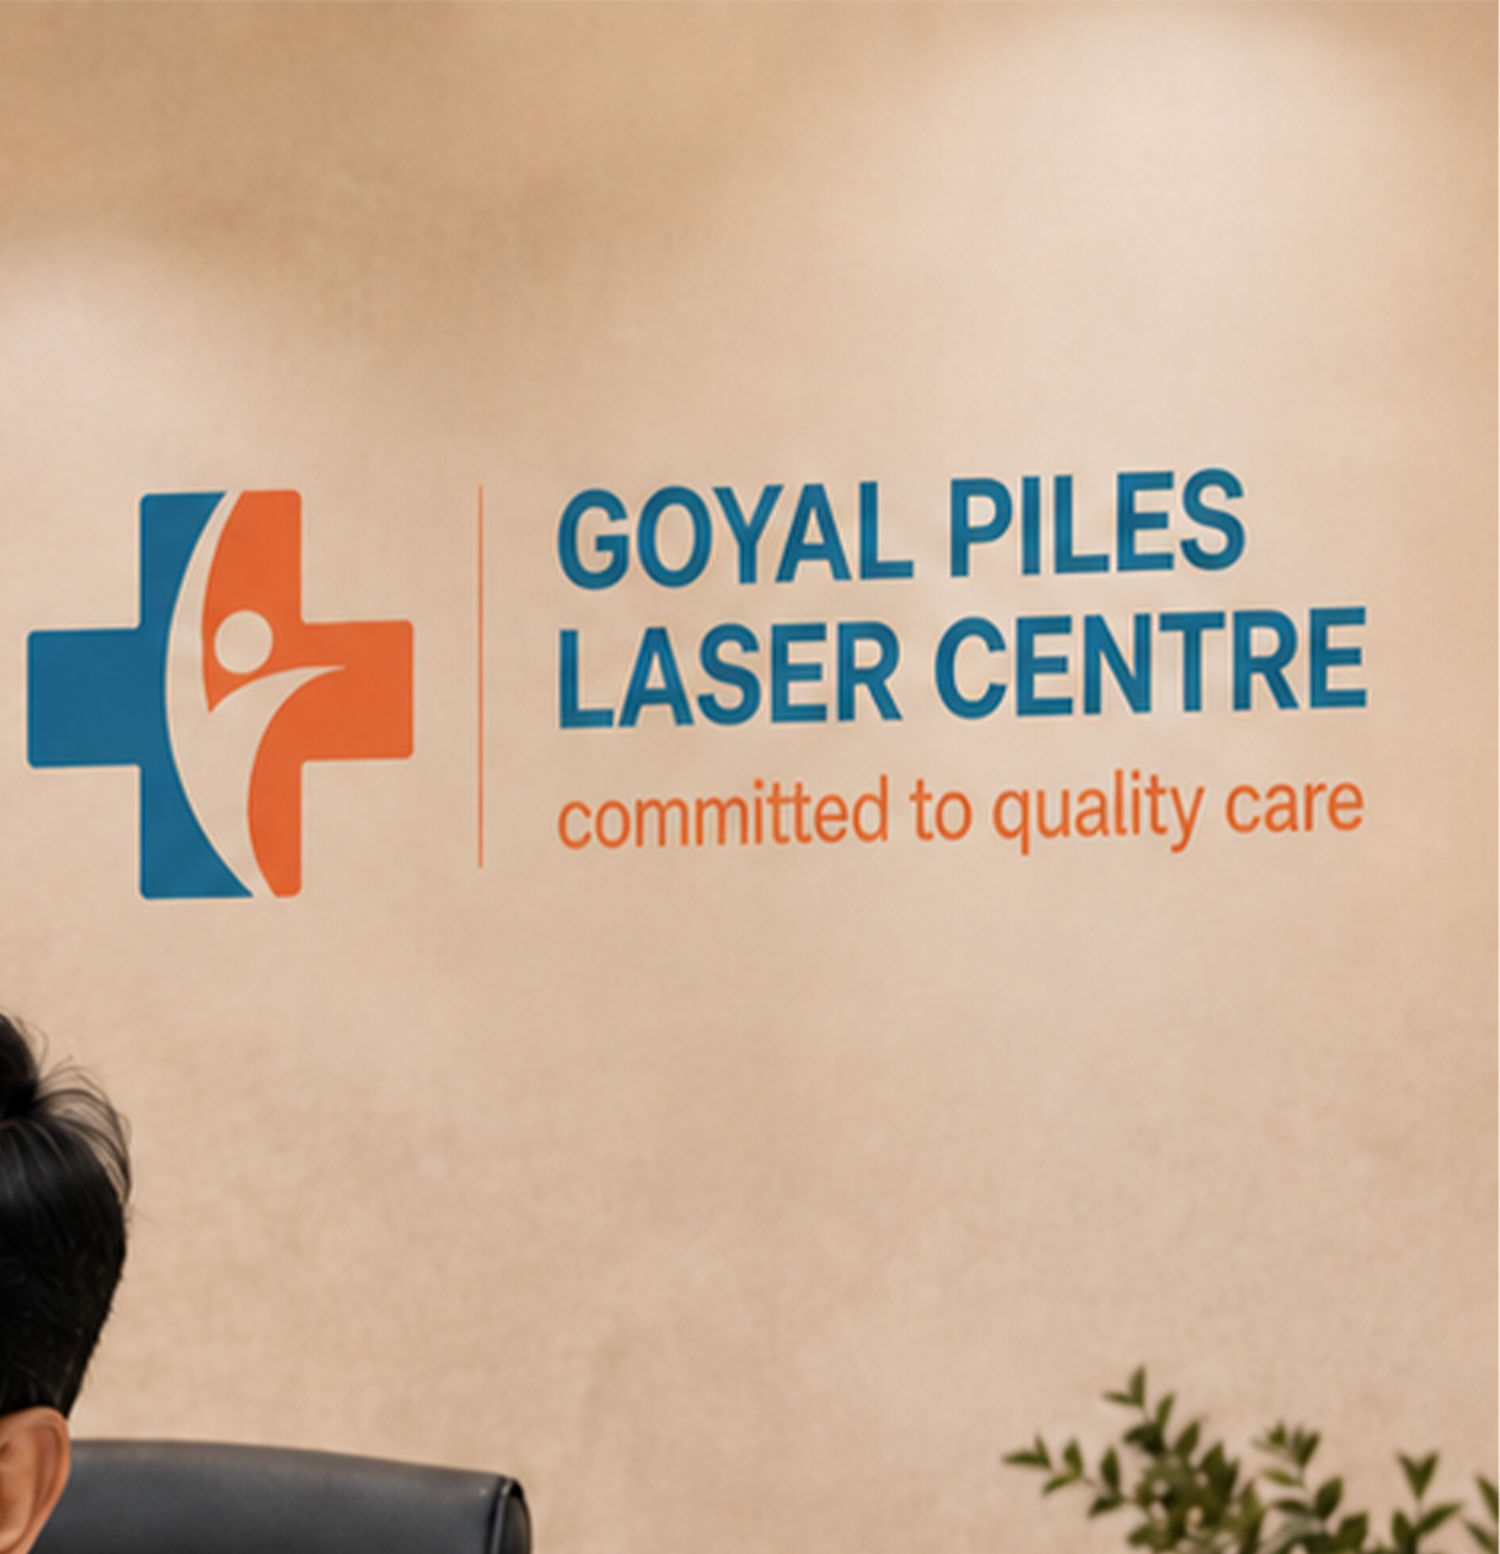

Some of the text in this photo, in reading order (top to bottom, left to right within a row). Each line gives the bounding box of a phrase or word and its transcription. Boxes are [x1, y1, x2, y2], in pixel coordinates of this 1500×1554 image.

[557, 468, 1246, 590] GOYAL PILES
[559, 606, 1367, 730] LASER CENTRE
[558, 769, 1364, 856] committed to quality care
